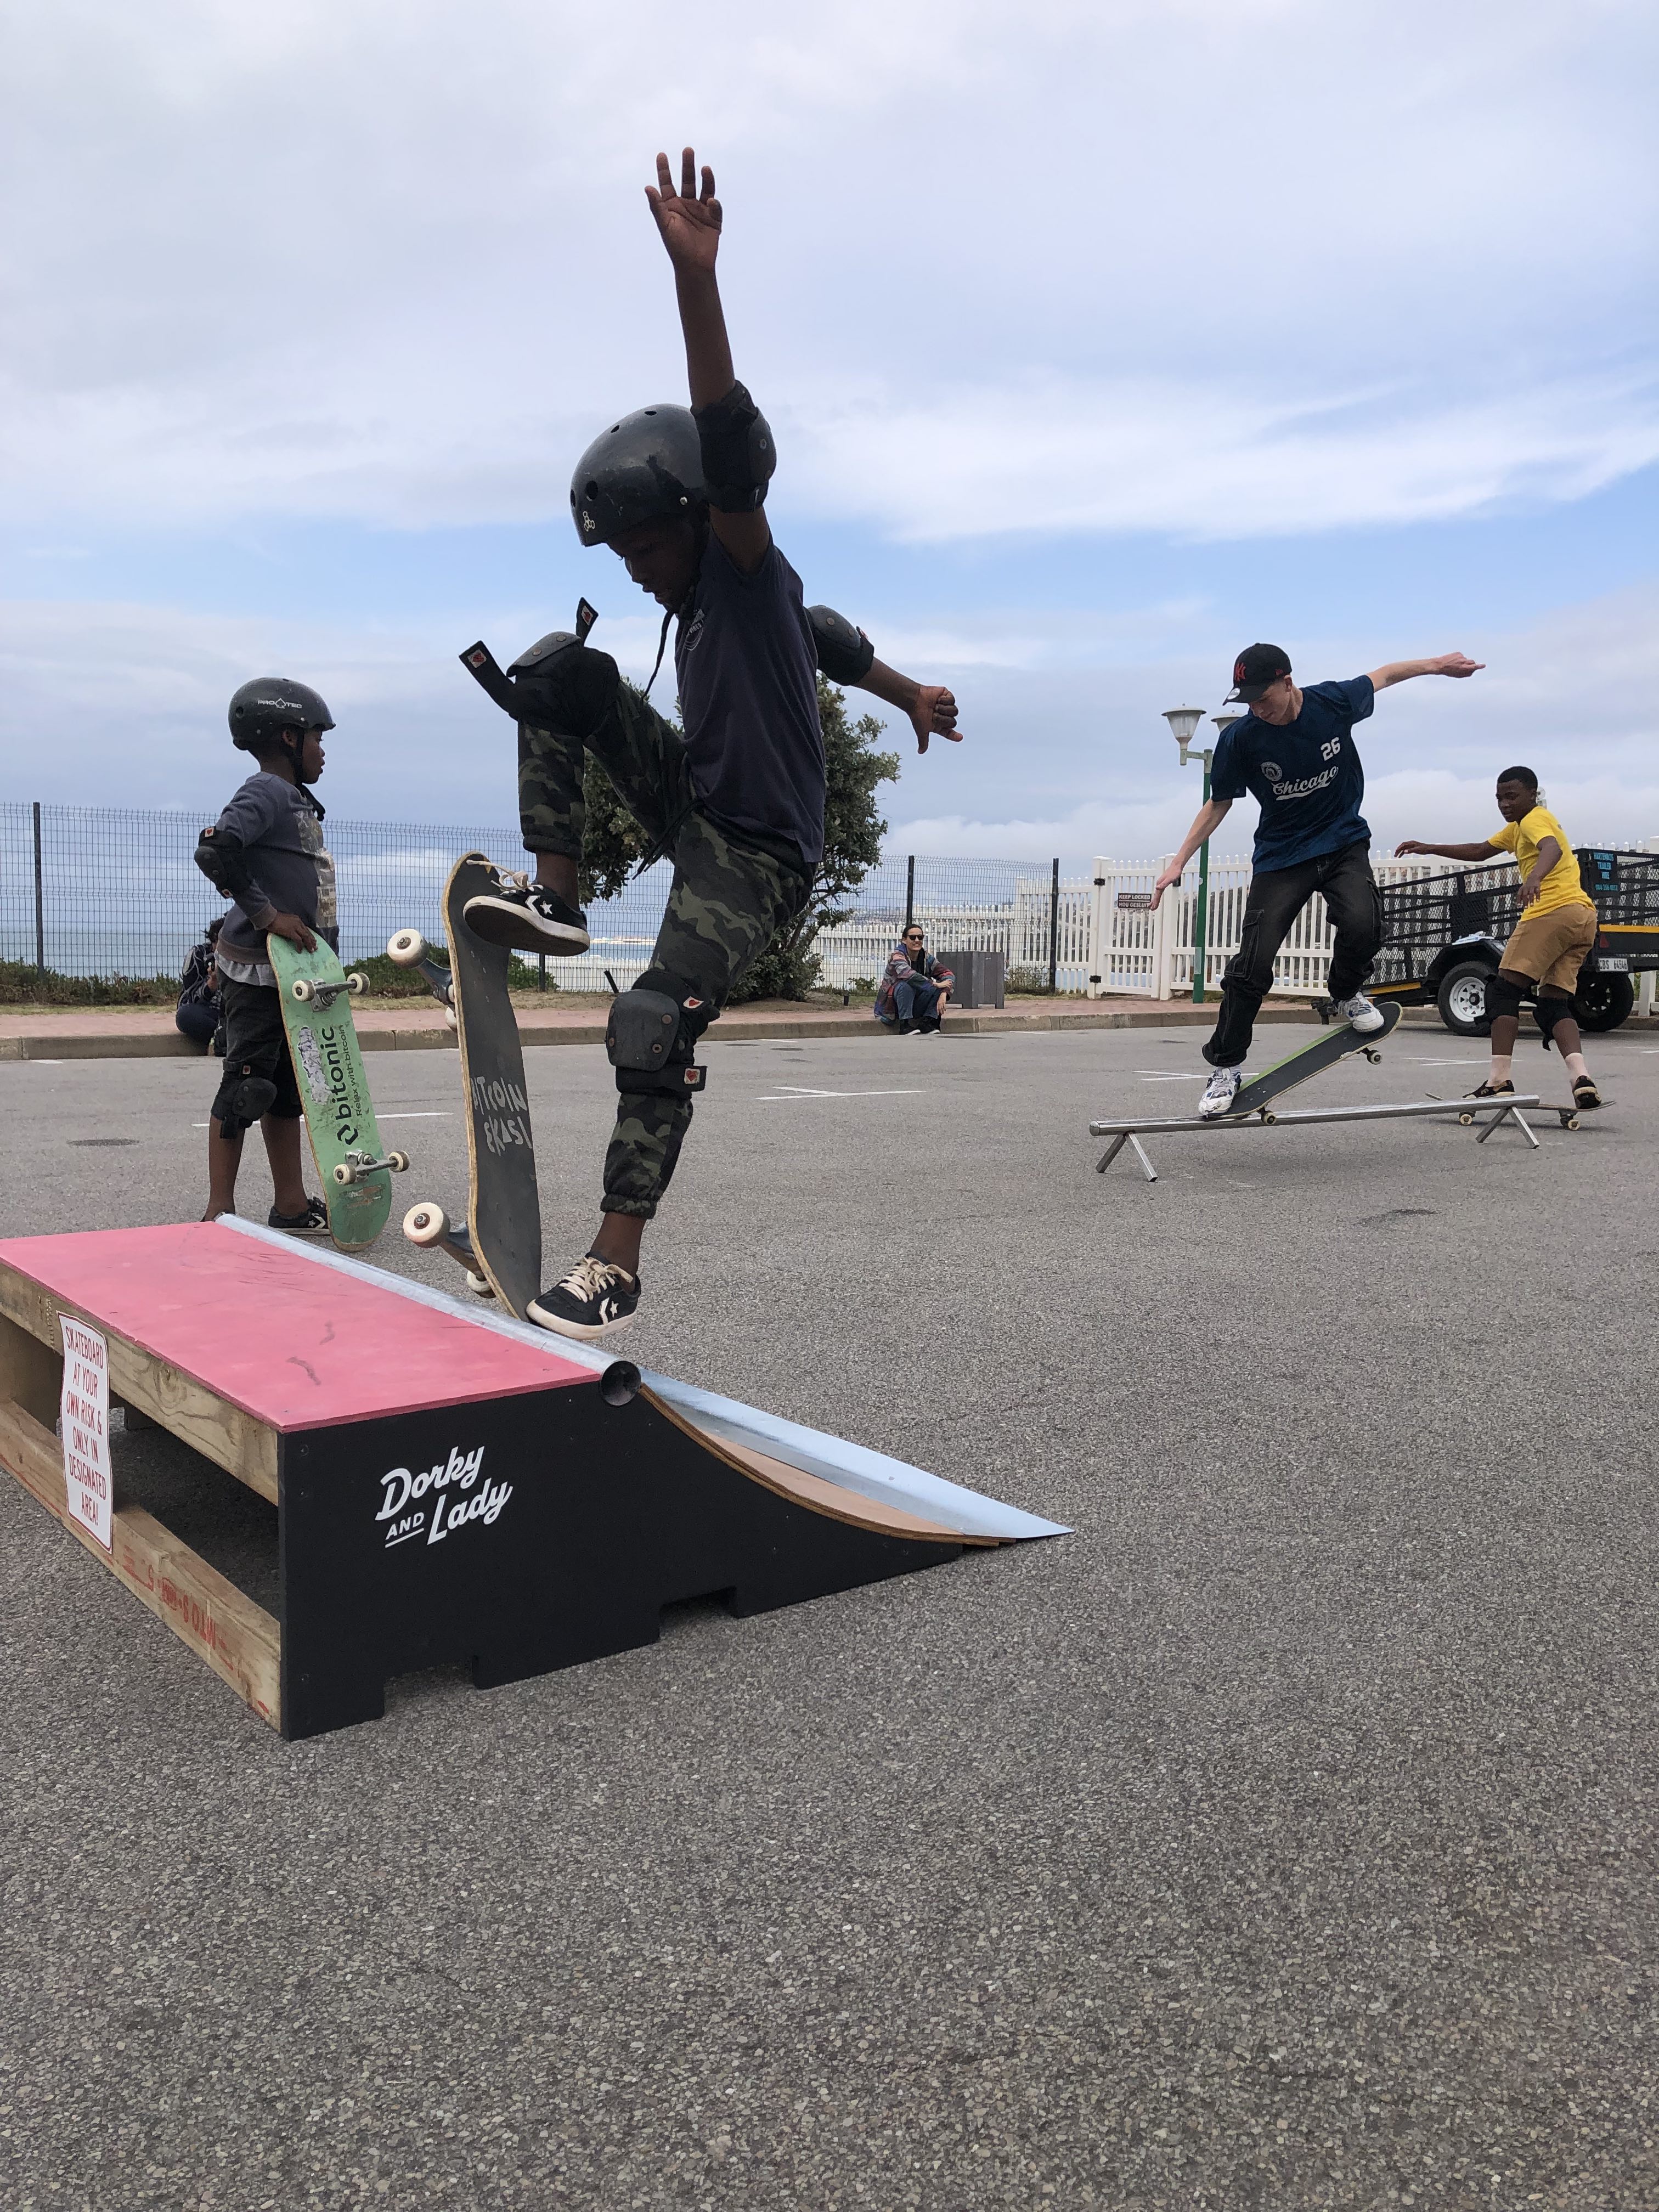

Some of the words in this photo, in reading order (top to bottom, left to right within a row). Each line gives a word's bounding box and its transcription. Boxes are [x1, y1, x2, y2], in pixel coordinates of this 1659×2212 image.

[1321, 737, 1341, 761] 26
[1271, 766, 1339, 795] Chicago
[338, 1025, 351, 1061] bitcoin
[320, 1026, 352, 1120] bitonic
[346, 1063, 356, 1086] with
[353, 1088, 363, 1116] Relax
[65, 1325, 104, 1369] SKATEBOARD
[72, 1361, 81, 1387] AT
[82, 1366, 98, 1400] YOUR
[66, 1390, 80, 1420] OWN
[81, 1400, 95, 1431] RISK
[97, 1410, 102, 1436] &
[73, 1426, 88, 1458] ONLY
[91, 1437, 99, 1464] IN
[69, 1453, 106, 1500] DESIGNATED
[375, 1446, 485, 1521] Dorky
[81, 1492, 99, 1526] AREA!
[385, 1512, 425, 1541] AND
[427, 1477, 514, 1545] Lady
